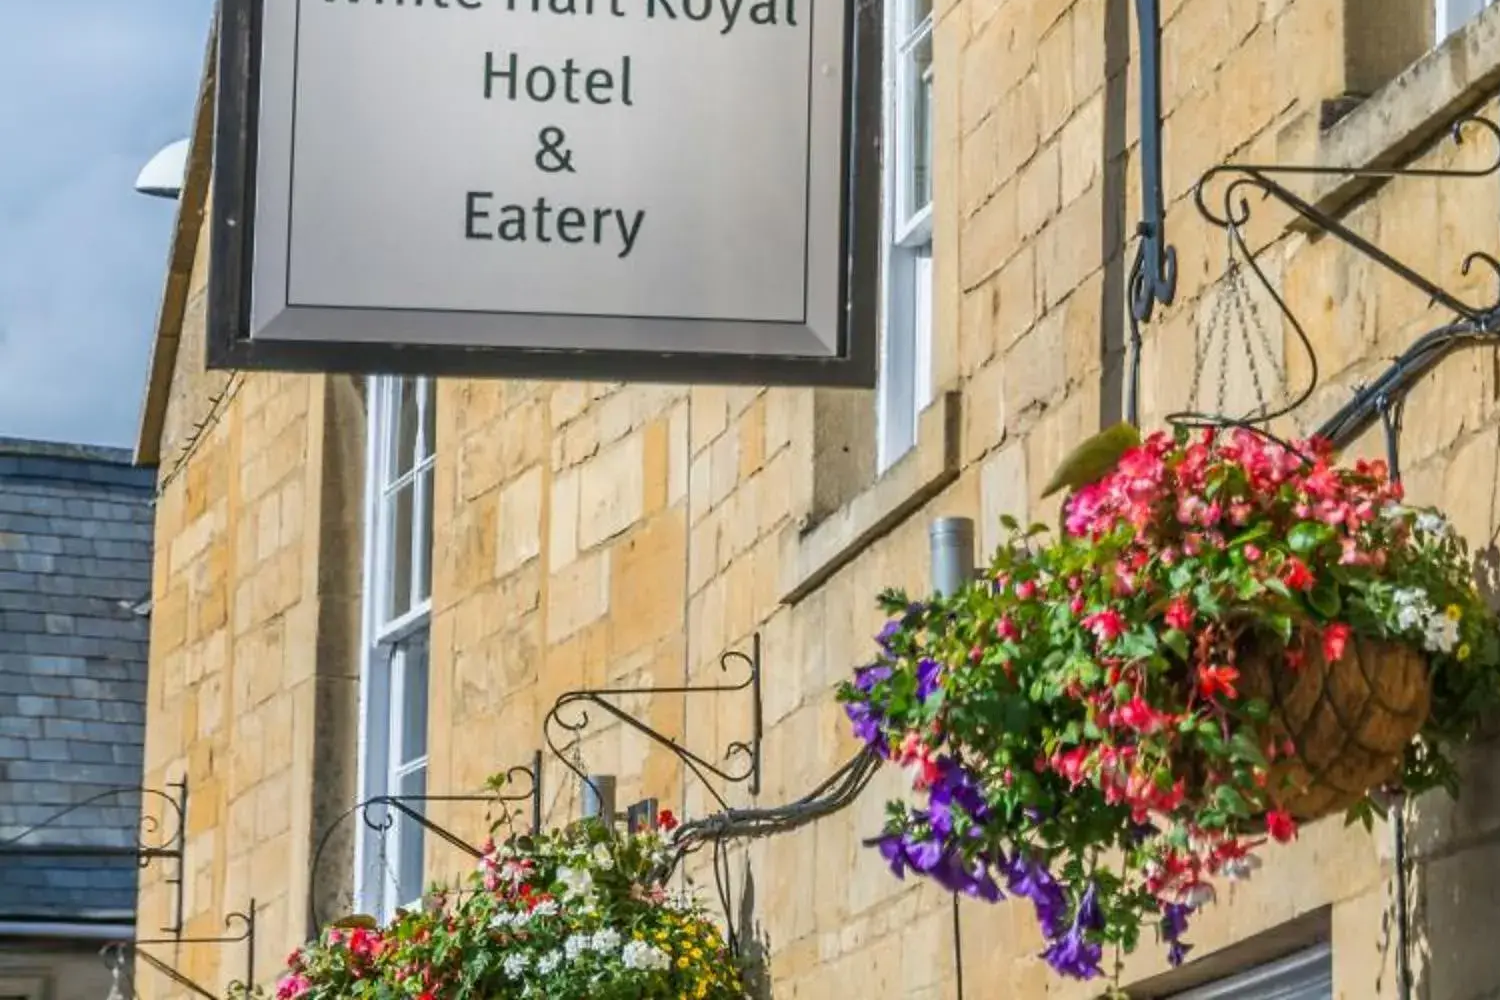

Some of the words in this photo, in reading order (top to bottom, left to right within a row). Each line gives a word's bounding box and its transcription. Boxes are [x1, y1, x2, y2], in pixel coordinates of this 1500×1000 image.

[483, 51, 634, 107] Hotel
[535, 126, 576, 173] &
[464, 191, 646, 259] Eatery
